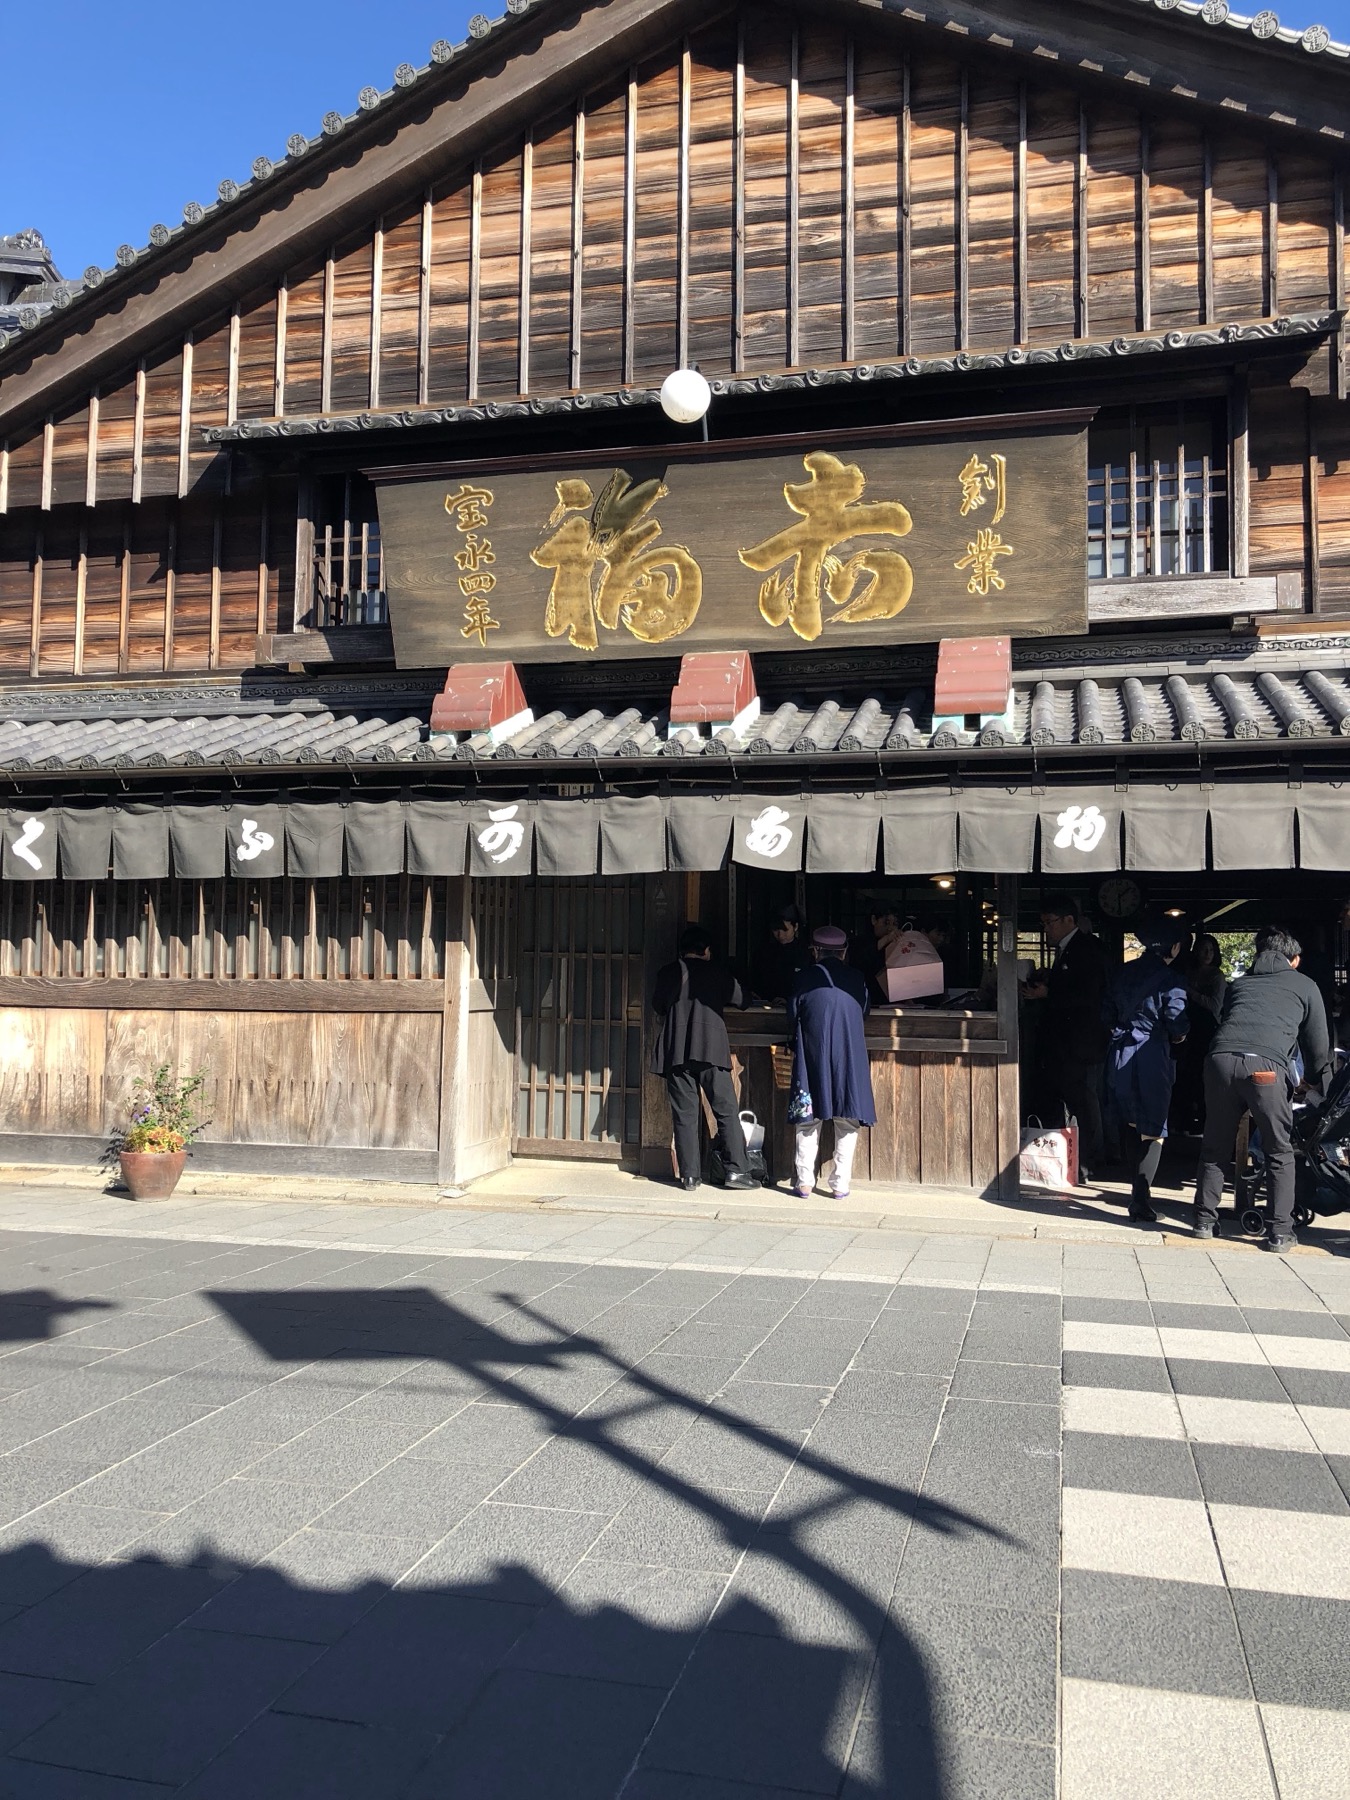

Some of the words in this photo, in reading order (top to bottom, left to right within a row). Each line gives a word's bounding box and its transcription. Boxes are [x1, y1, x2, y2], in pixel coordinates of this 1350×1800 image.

[444, 484, 501, 647] 宝永四年
[11, 817, 45, 871] く
